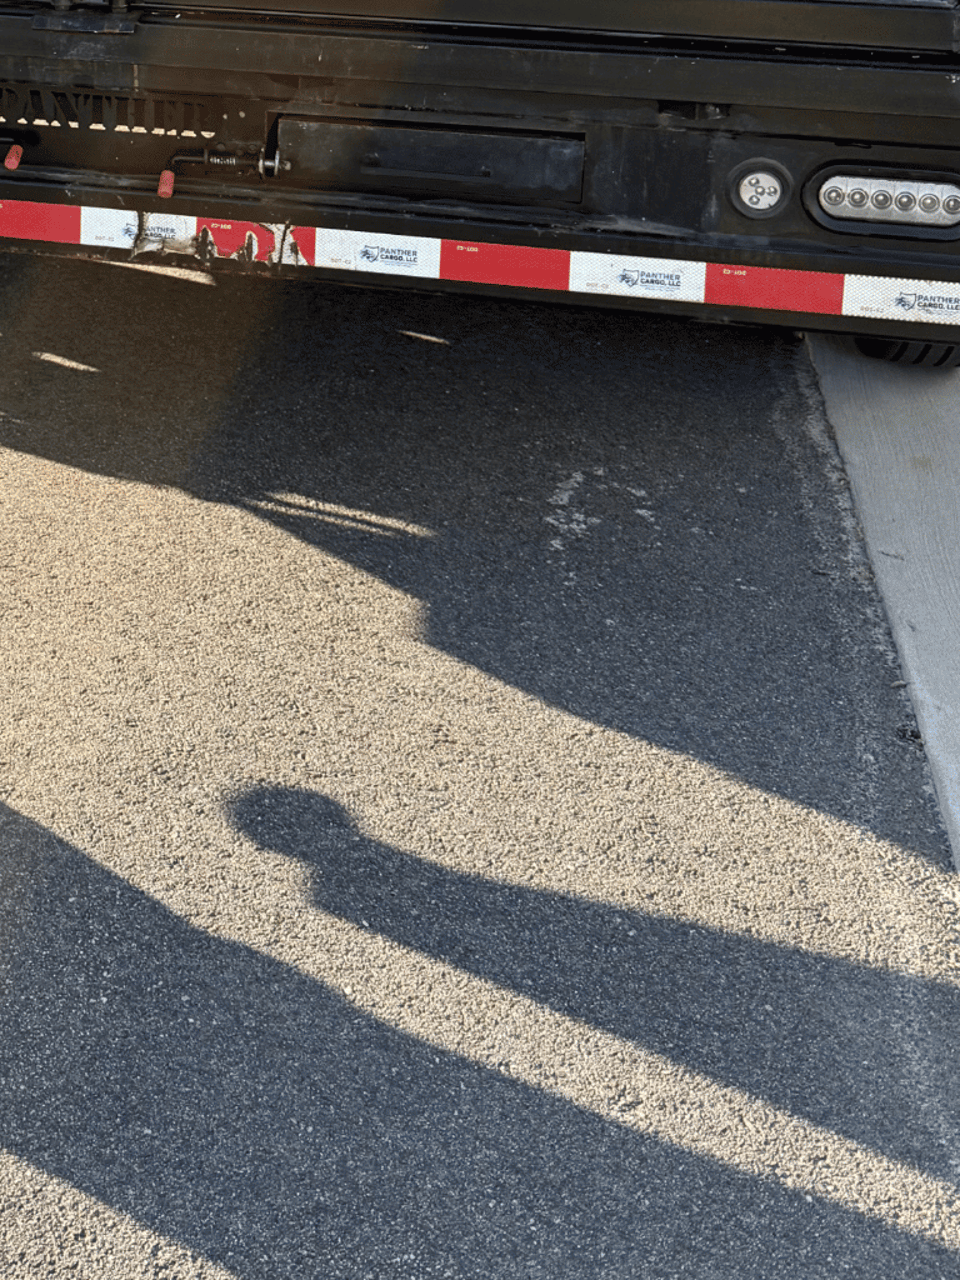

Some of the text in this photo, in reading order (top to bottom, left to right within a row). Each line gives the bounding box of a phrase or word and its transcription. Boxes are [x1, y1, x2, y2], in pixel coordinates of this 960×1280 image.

[146, 226, 176, 235] ANTHER
[380, 247, 418, 257] PANTHER
[640, 271, 681, 281] PANTHER
